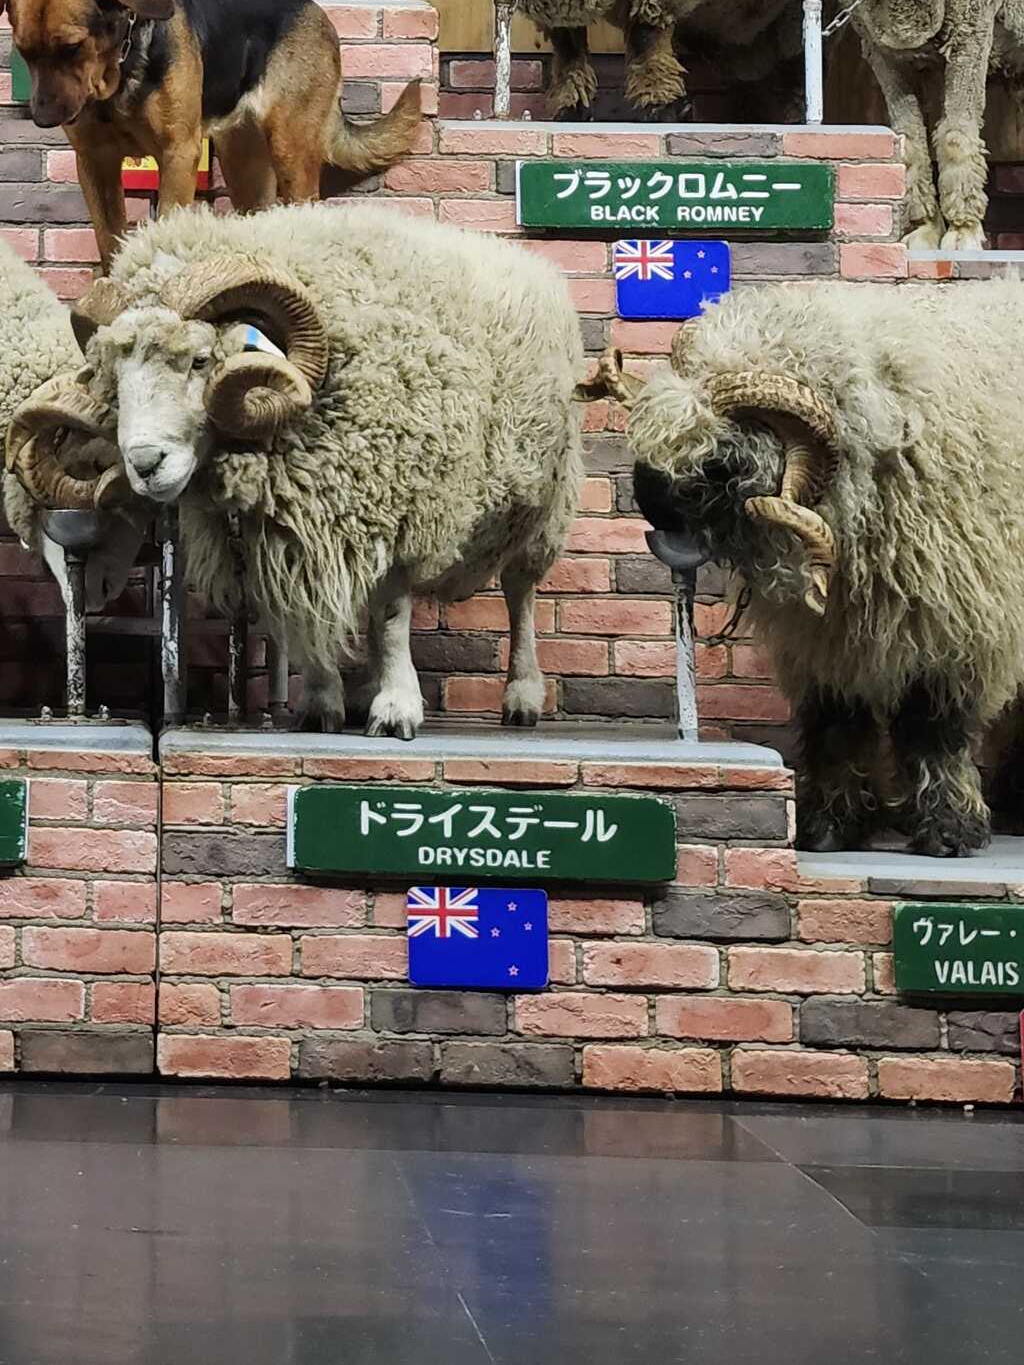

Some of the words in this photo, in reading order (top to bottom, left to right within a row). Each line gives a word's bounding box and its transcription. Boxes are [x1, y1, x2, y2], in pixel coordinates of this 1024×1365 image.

[553, 169, 802, 200] ブラックロムニー
[590, 205, 660, 221] BLACK
[677, 206, 765, 222] ROMNEY
[360, 799, 618, 843] ドライスデール
[417, 845, 552, 869] DRYSDALE
[934, 960, 1020, 986] VALAIS
